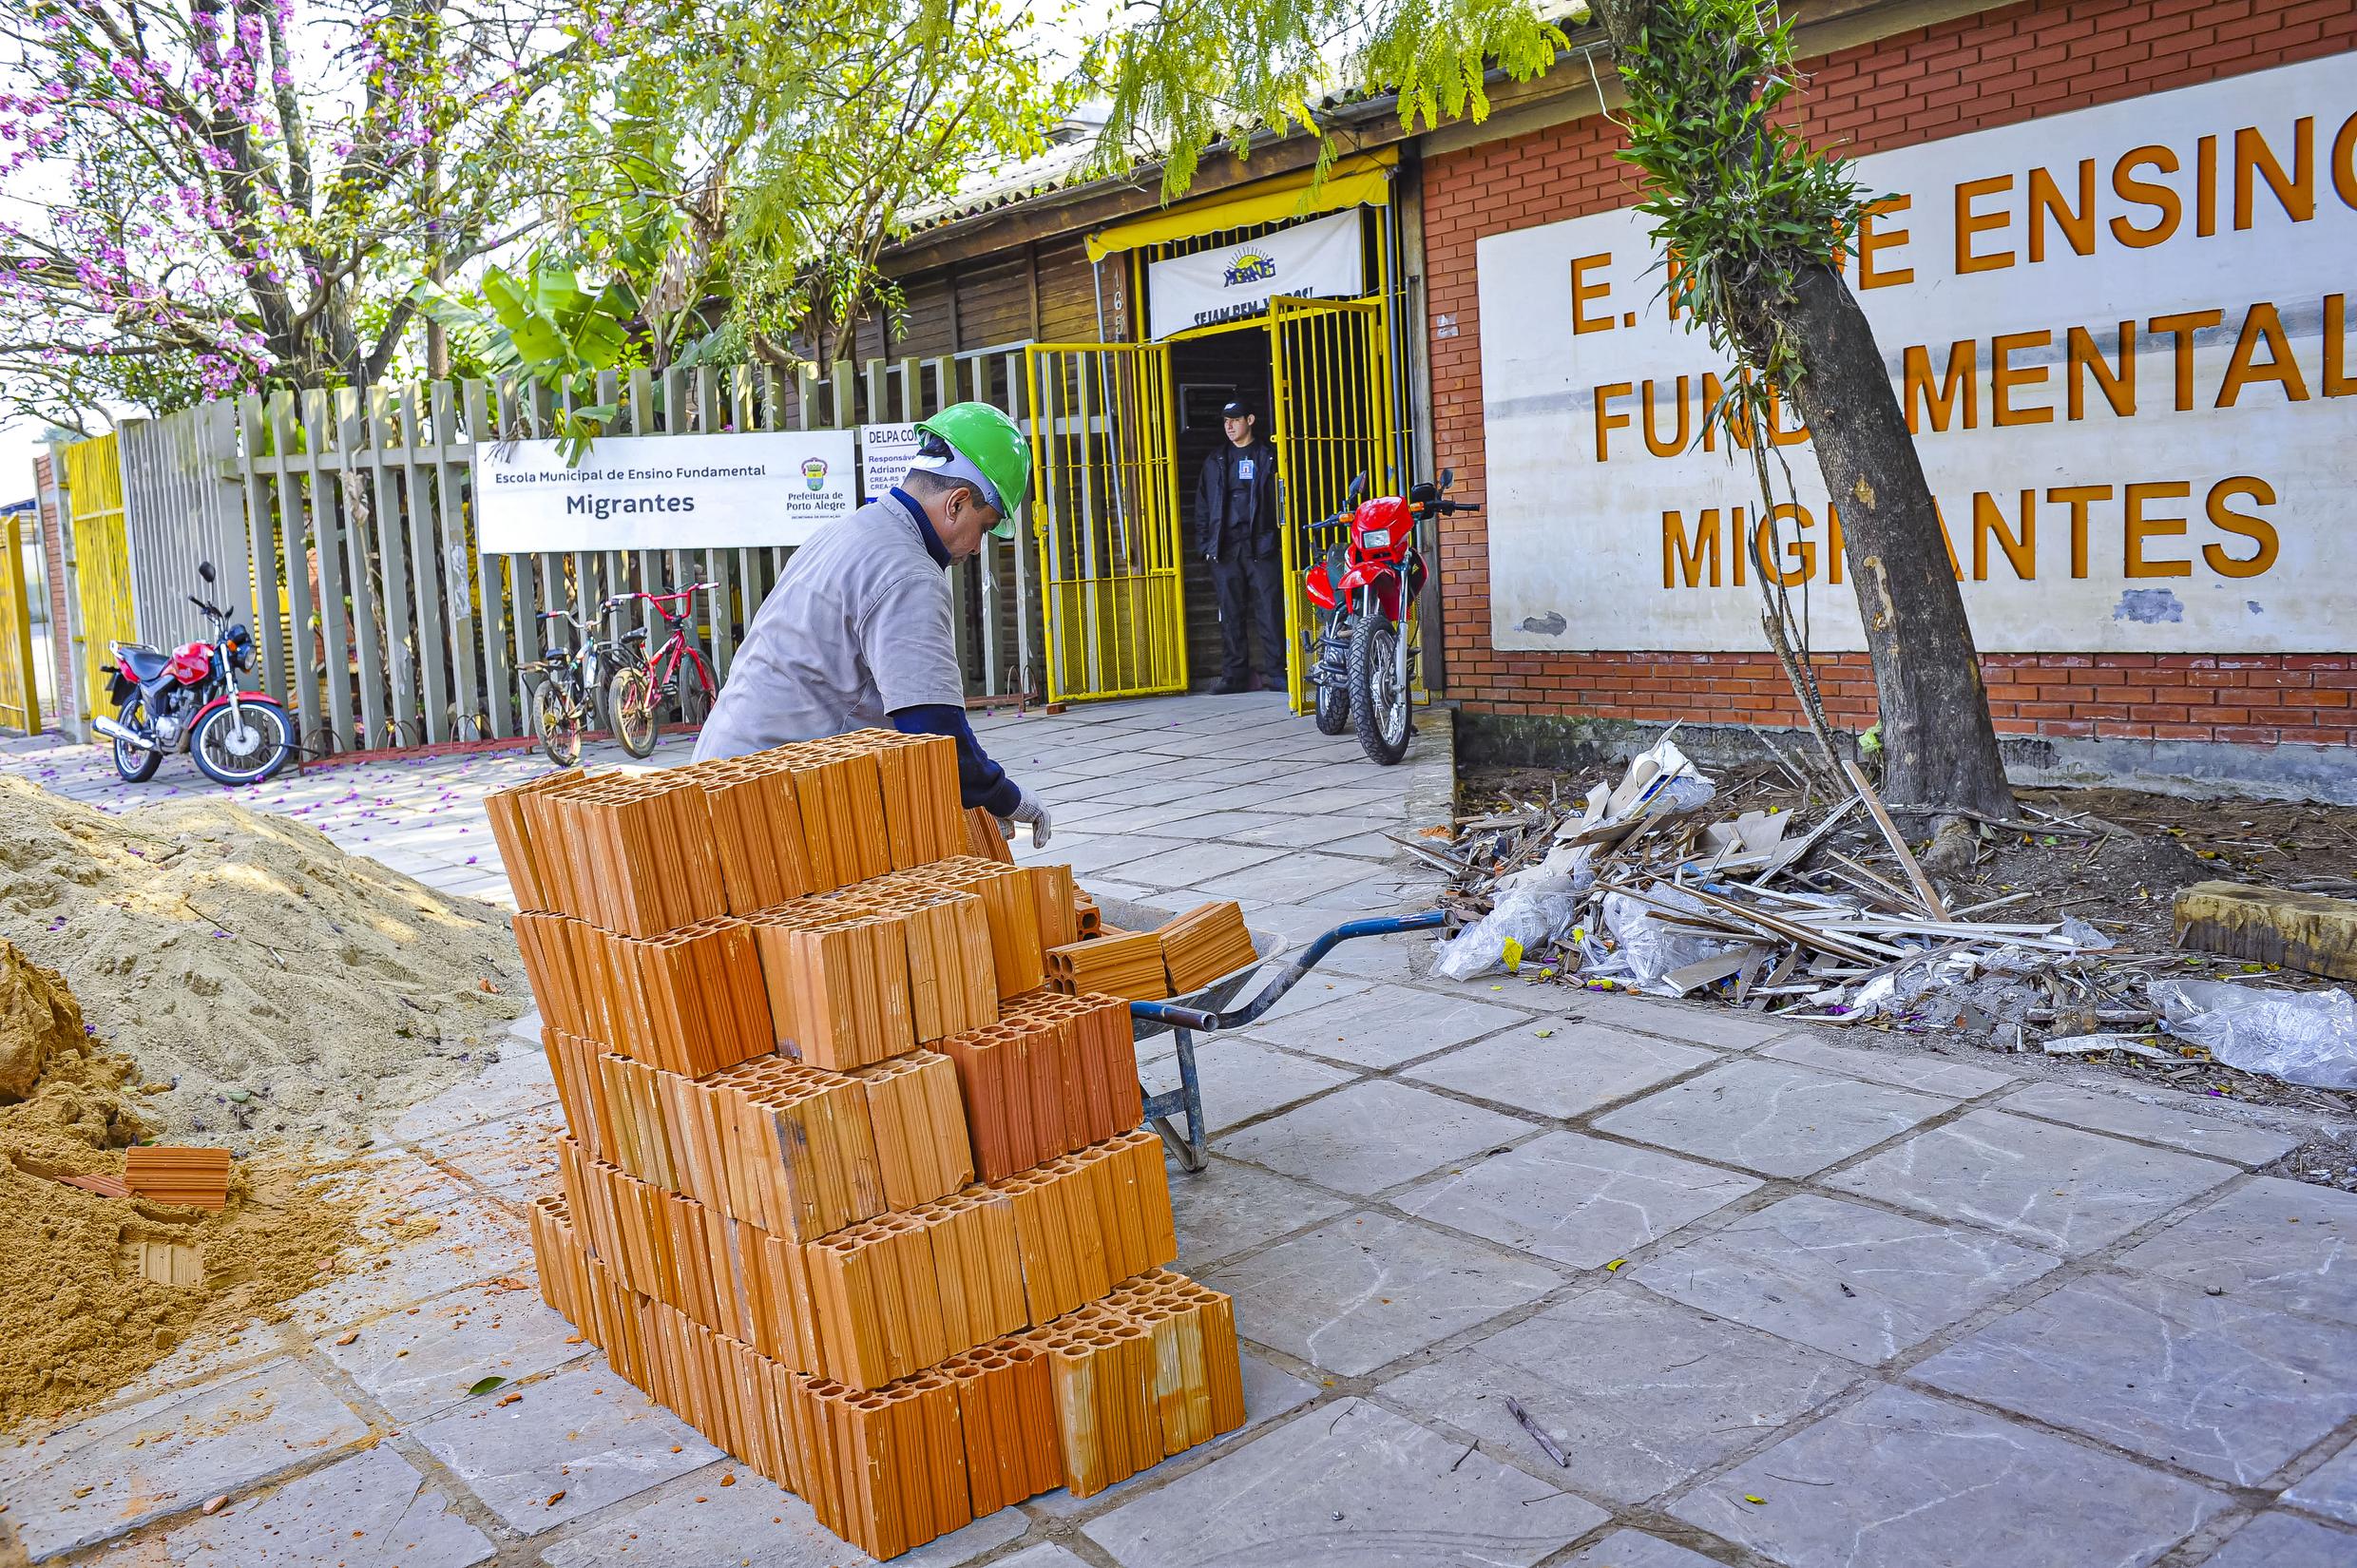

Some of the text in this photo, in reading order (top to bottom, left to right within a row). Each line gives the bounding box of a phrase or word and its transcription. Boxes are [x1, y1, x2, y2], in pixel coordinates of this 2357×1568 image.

[1570, 251, 1637, 336] E.
[1593, 293, 2357, 463] FUNDMENTAL
[869, 429, 917, 444] DELPA CO
[868, 453, 916, 464] Responsáve
[495, 465, 766, 484] Escola Municipal de Ensino Fundamental
[870, 465, 907, 474] Adriano
[788, 491, 844, 501] Prefeitura de
[566, 493, 695, 520] Migrantes
[786, 501, 846, 511] Porto Alegre
[1662, 475, 2280, 589] MIGNTES
